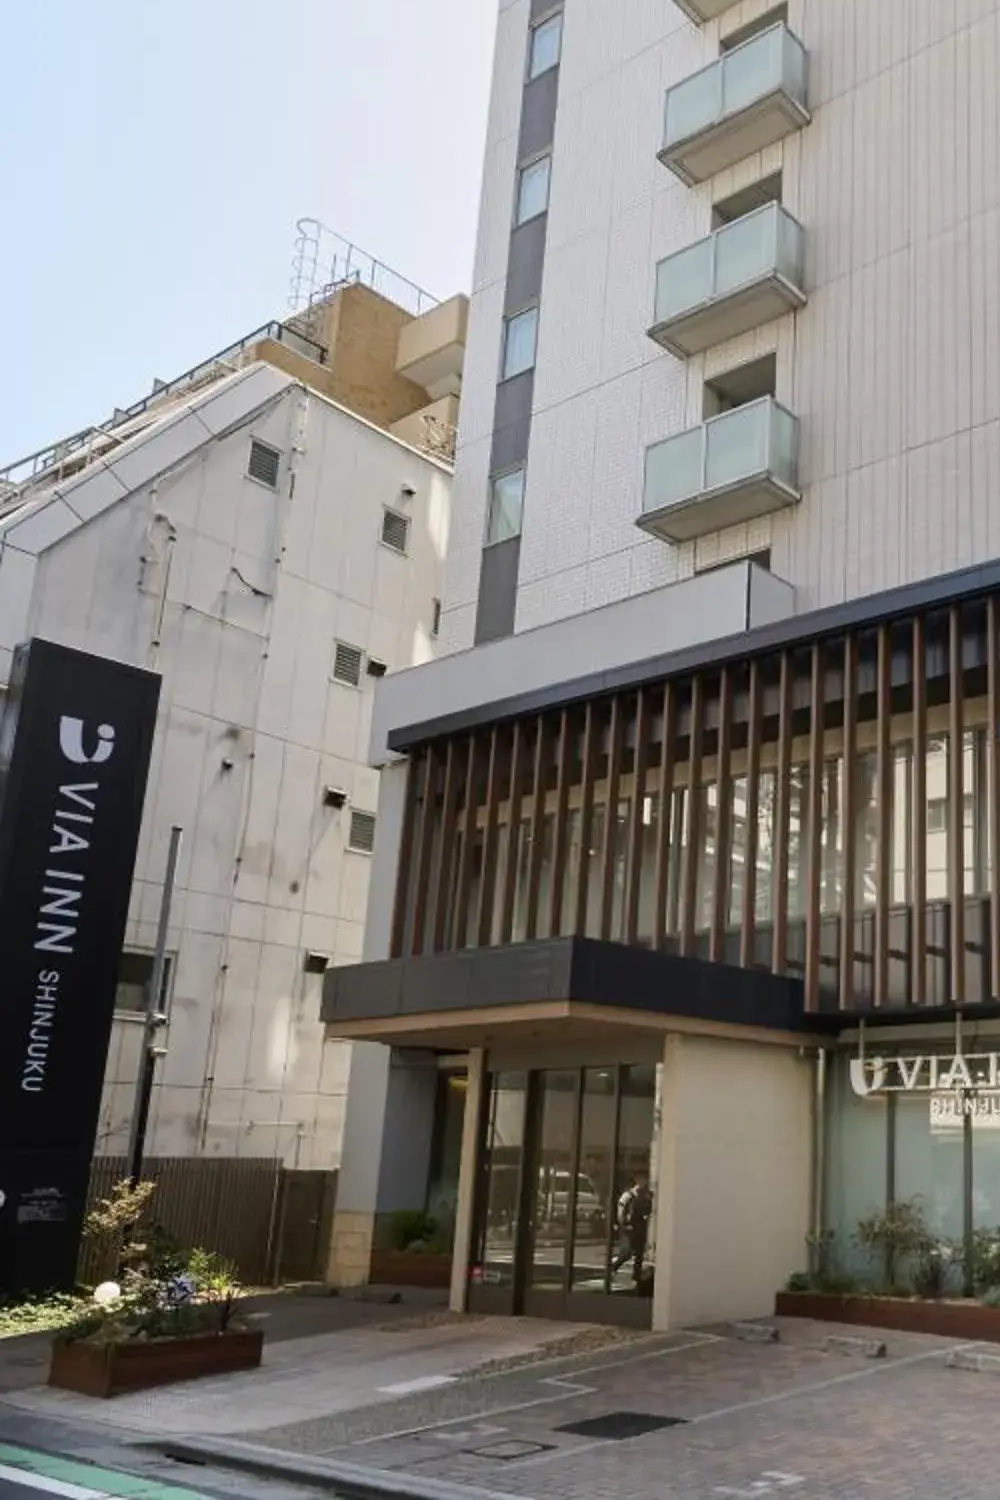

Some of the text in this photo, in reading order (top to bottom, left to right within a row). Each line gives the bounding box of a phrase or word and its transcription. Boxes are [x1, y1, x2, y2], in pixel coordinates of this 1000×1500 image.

[20, 782, 99, 1092] VIA INN SHINJUKU
[896, 1053, 972, 1089] VIA
